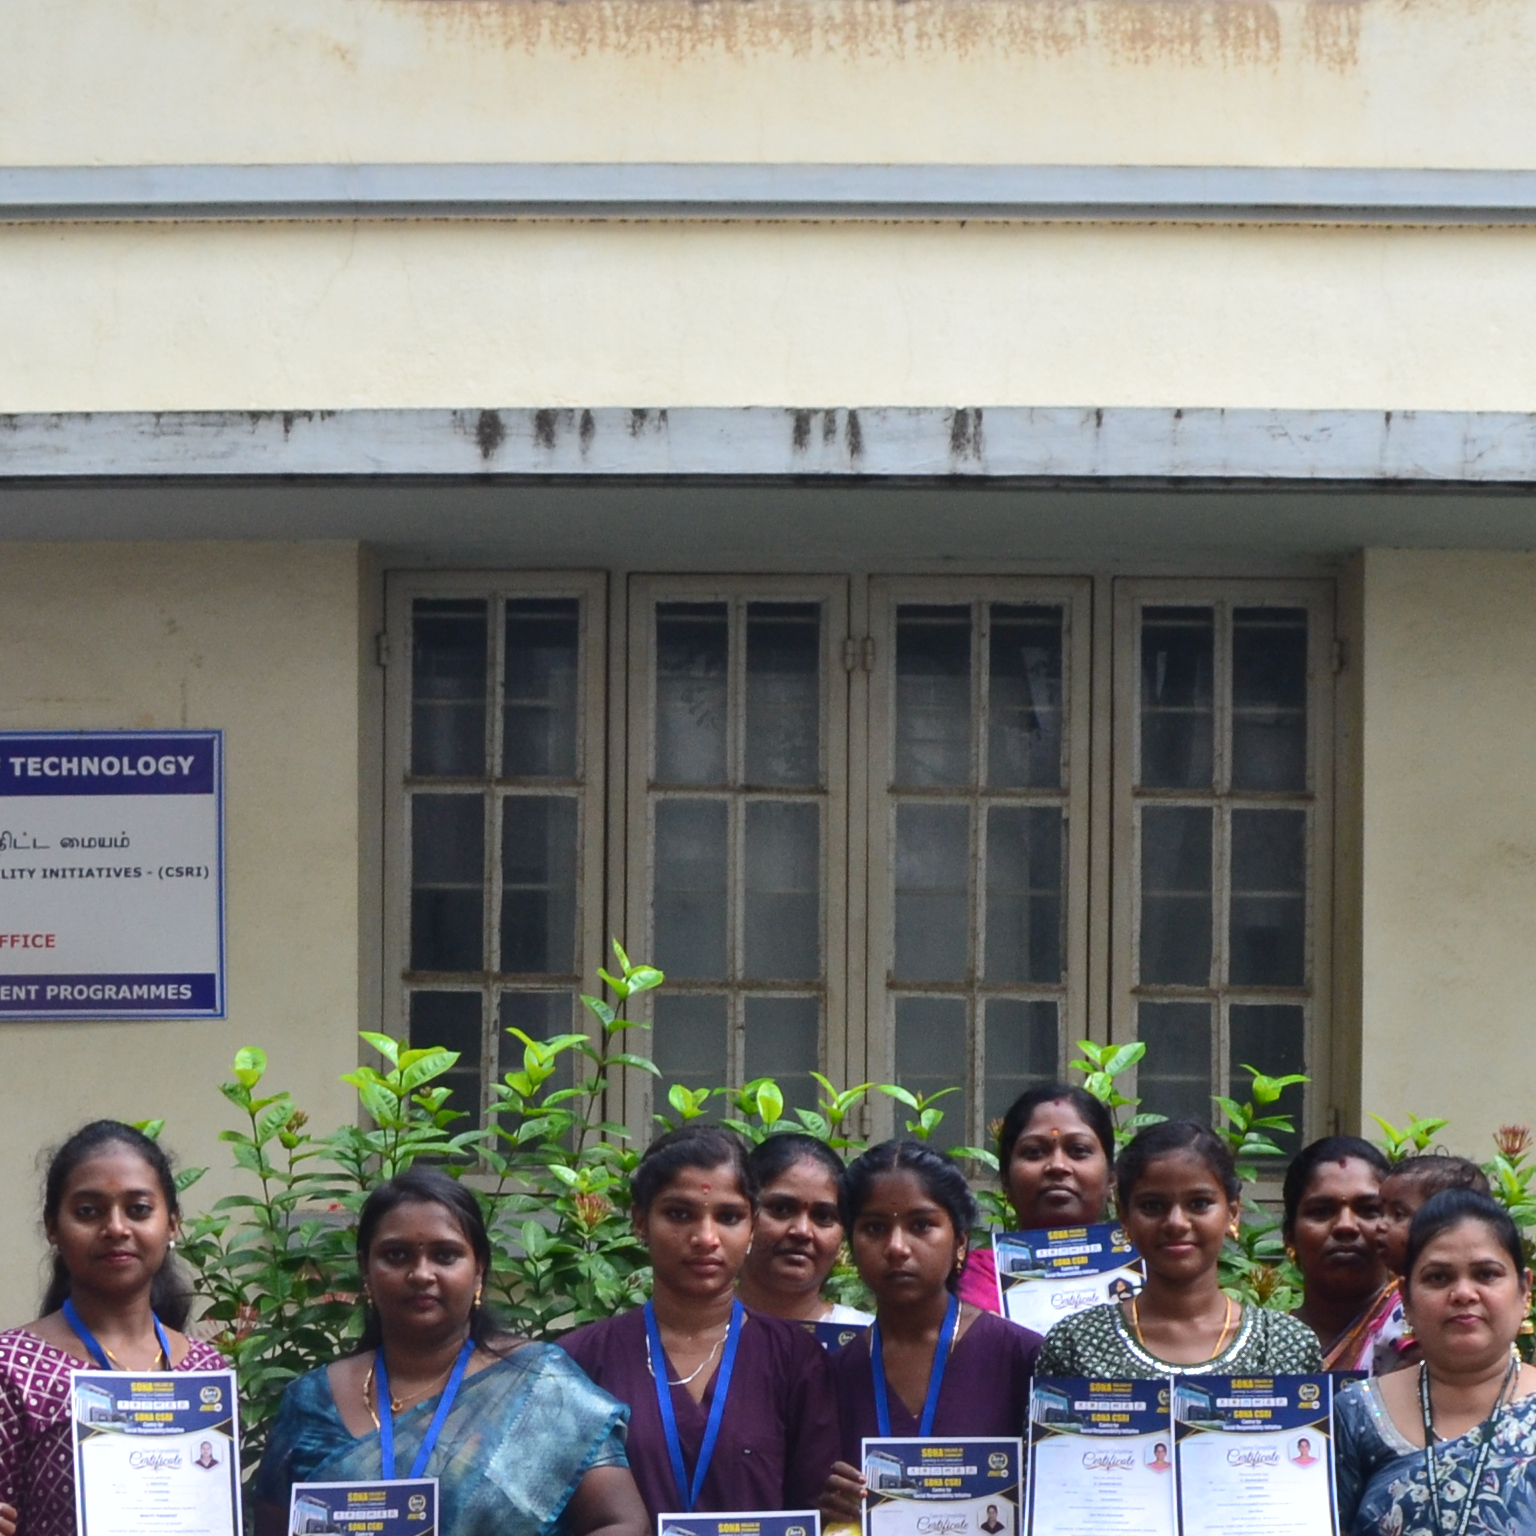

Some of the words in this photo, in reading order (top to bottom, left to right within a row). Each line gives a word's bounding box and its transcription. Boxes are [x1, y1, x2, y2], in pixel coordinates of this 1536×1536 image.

[13, 755, 195, 777] TECHNOLOGY
[60, 831, 130, 851] மையம்
[42, 867, 142, 879] INITIATIVES
[158, 865, 210, 880] (CSRI)
[46, 984, 193, 1001] PROGRAMMES
[129, 1451, 183, 1472] Certificate
[1083, 1451, 1135, 1473] Certificate
[1227, 1448, 1280, 1469] Certificate
[917, 1516, 969, 1536] Certificate
